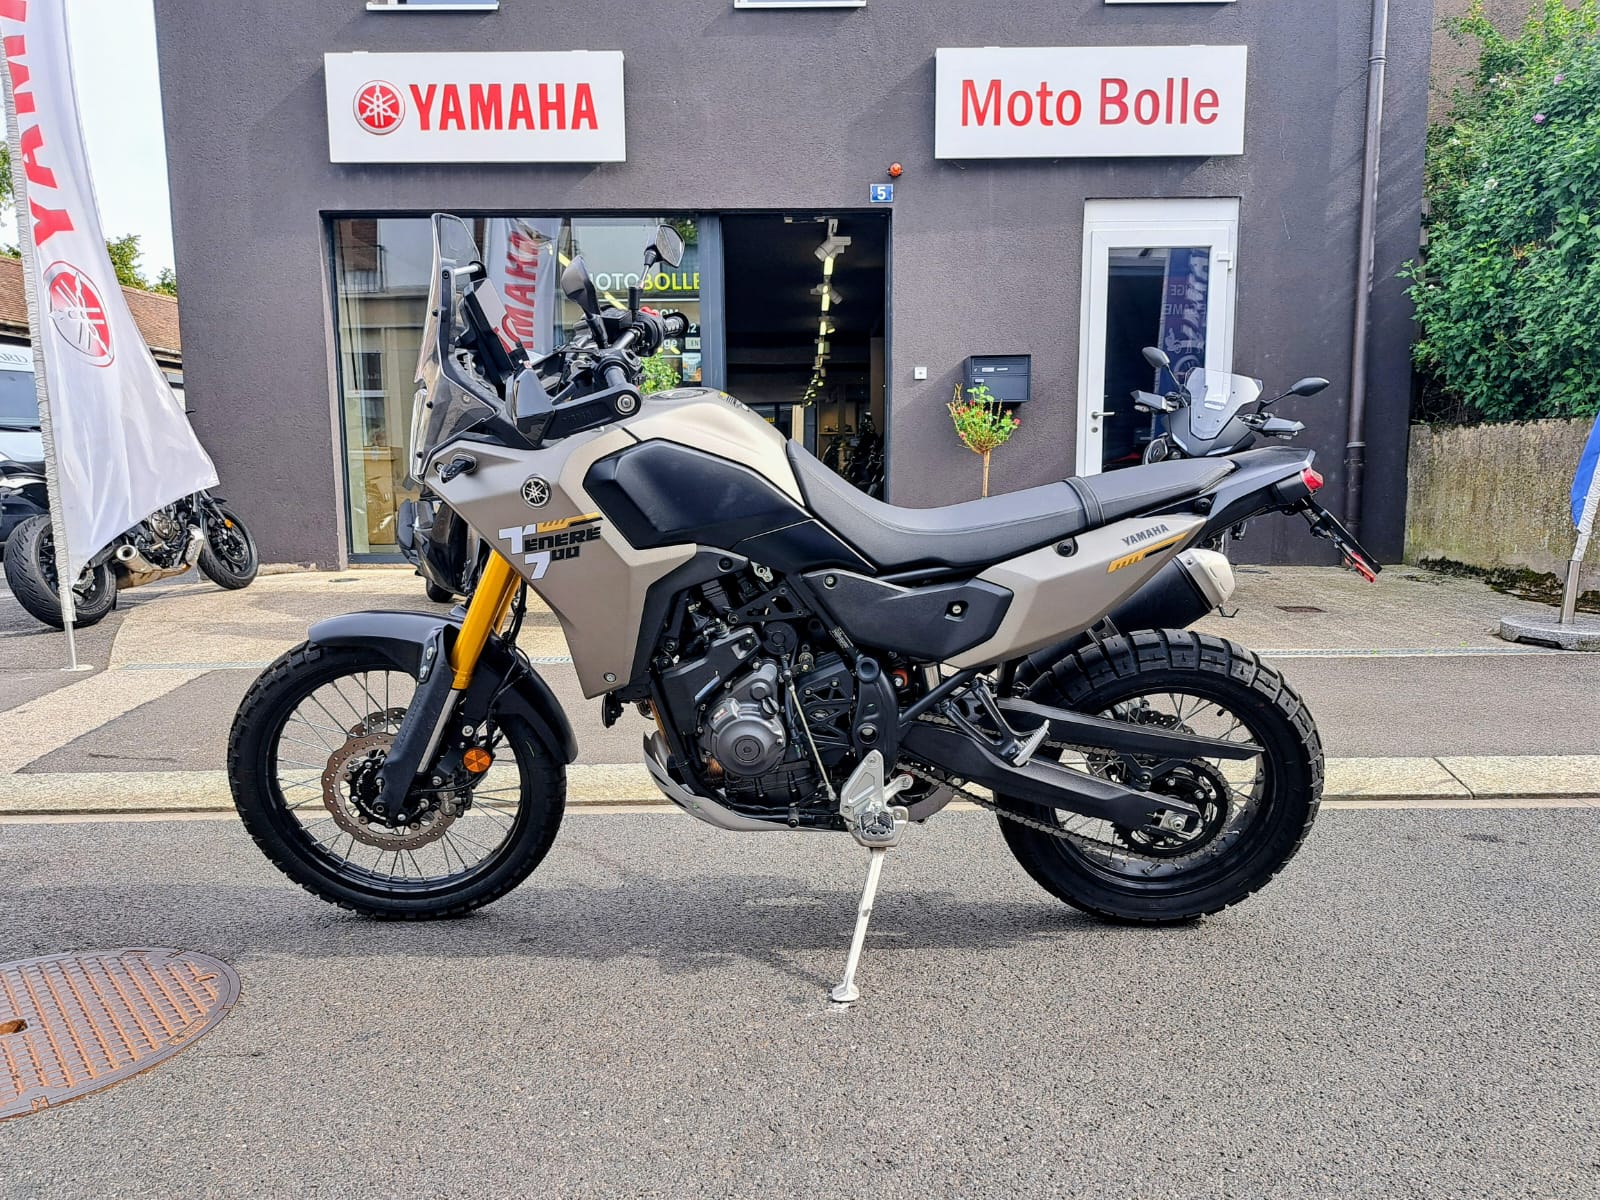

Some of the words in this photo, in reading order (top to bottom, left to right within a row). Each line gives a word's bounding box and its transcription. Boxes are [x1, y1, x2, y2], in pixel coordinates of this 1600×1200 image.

[408, 83, 599, 131] YAMAHA
[961, 79, 1082, 127] Moto
[1099, 77, 1220, 126] Bolle
[0, 0, 74, 247] YAM
[877, 186, 886, 200] 5
[1121, 523, 1169, 546] YAMAHA
[524, 546, 580, 580] 700
